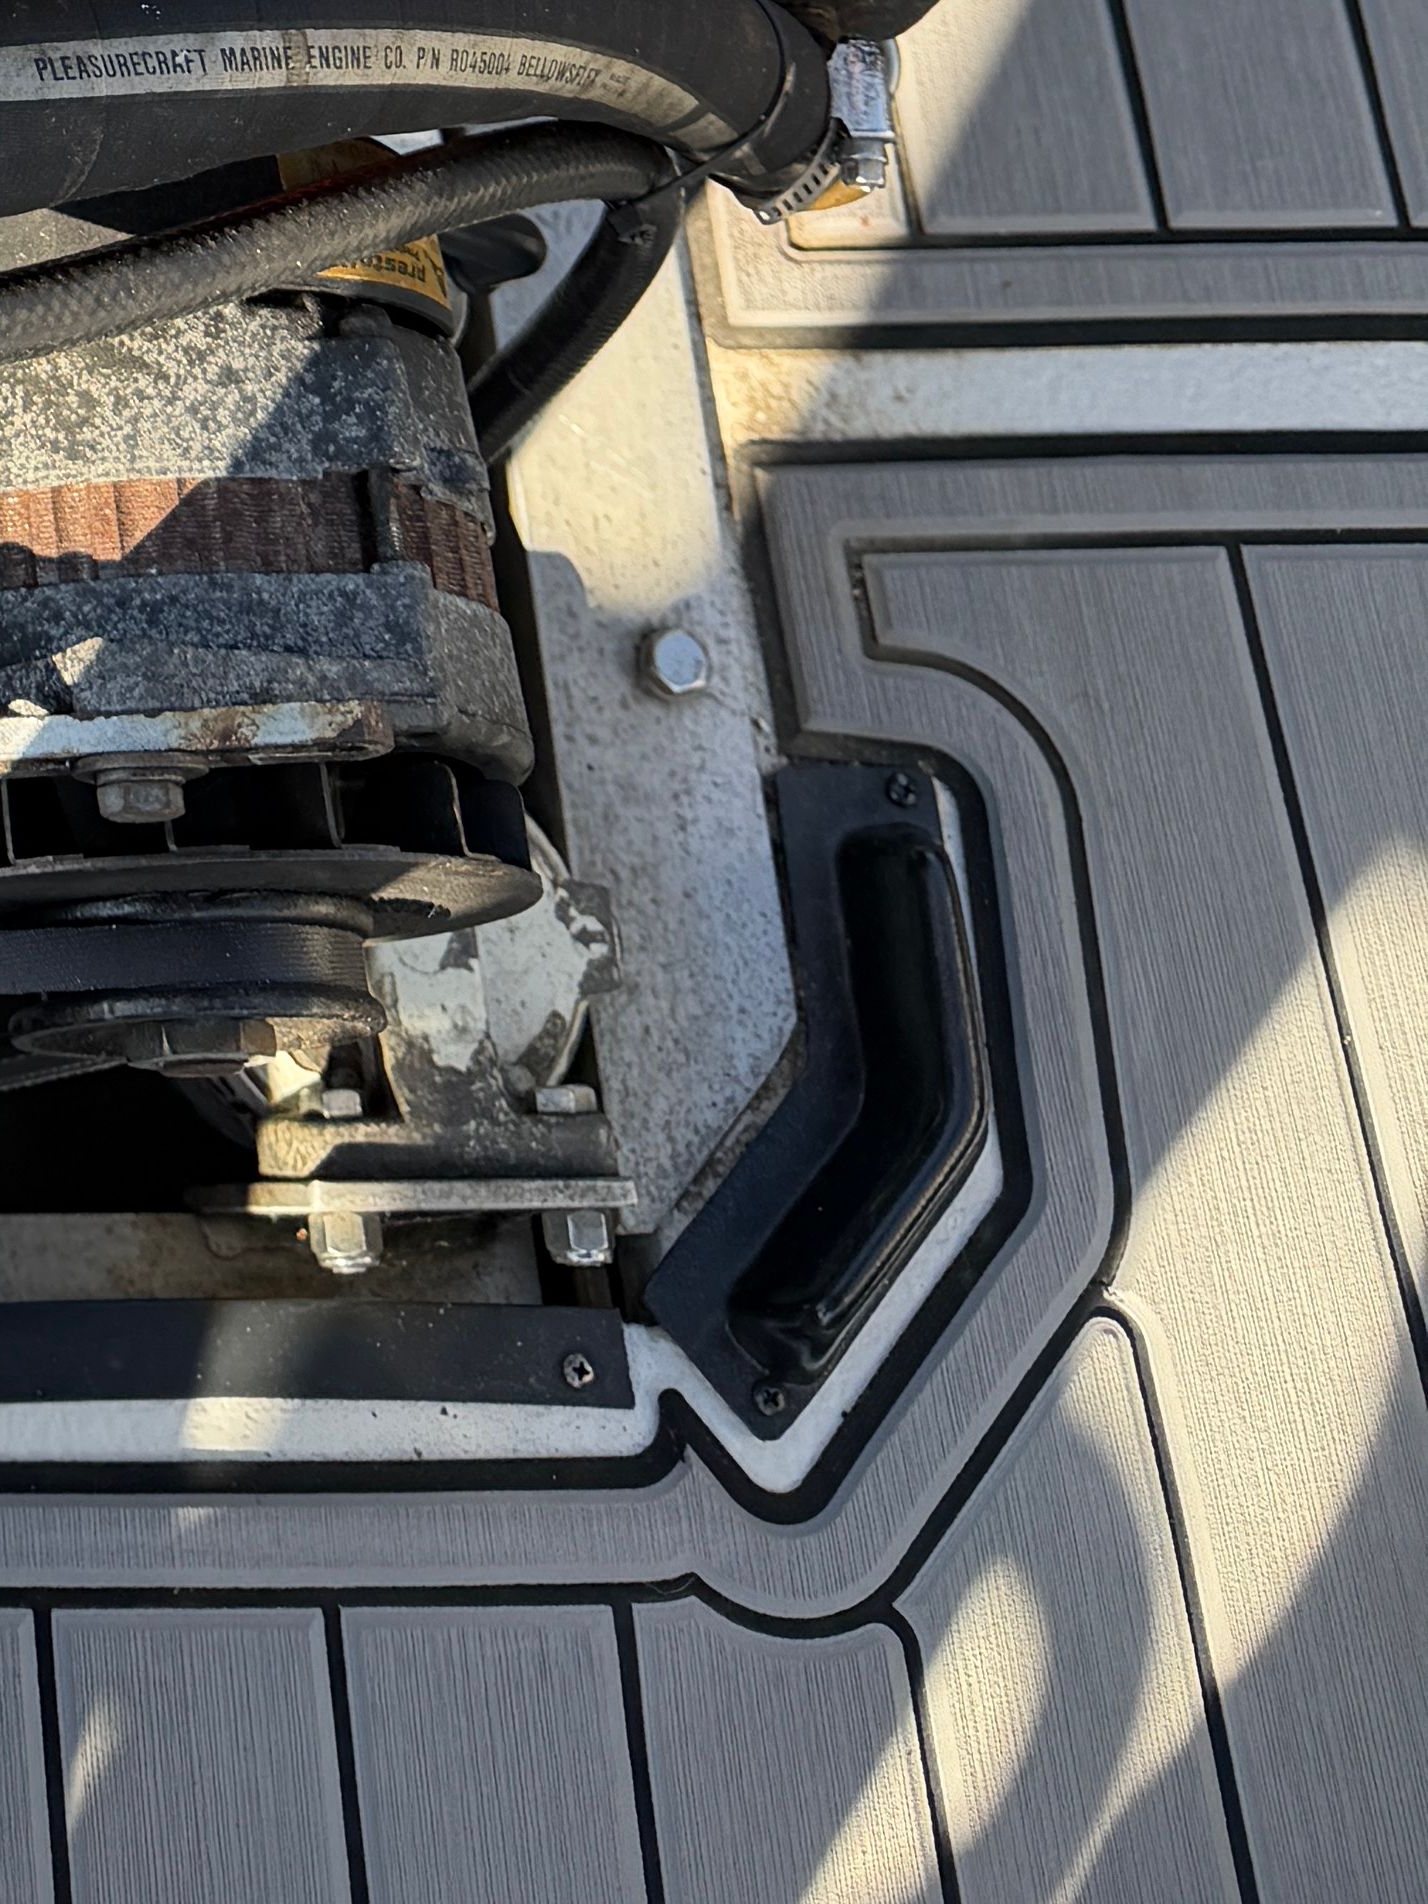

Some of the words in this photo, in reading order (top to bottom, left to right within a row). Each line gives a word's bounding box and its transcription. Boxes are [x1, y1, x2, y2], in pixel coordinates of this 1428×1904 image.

[34, 48, 208, 83] PLEASURECRAFT
[219, 43, 294, 72] MARINE
[307, 42, 372, 71] ENGINE
[384, 48, 406, 70] CO.
[340, 255, 426, 282] presto
